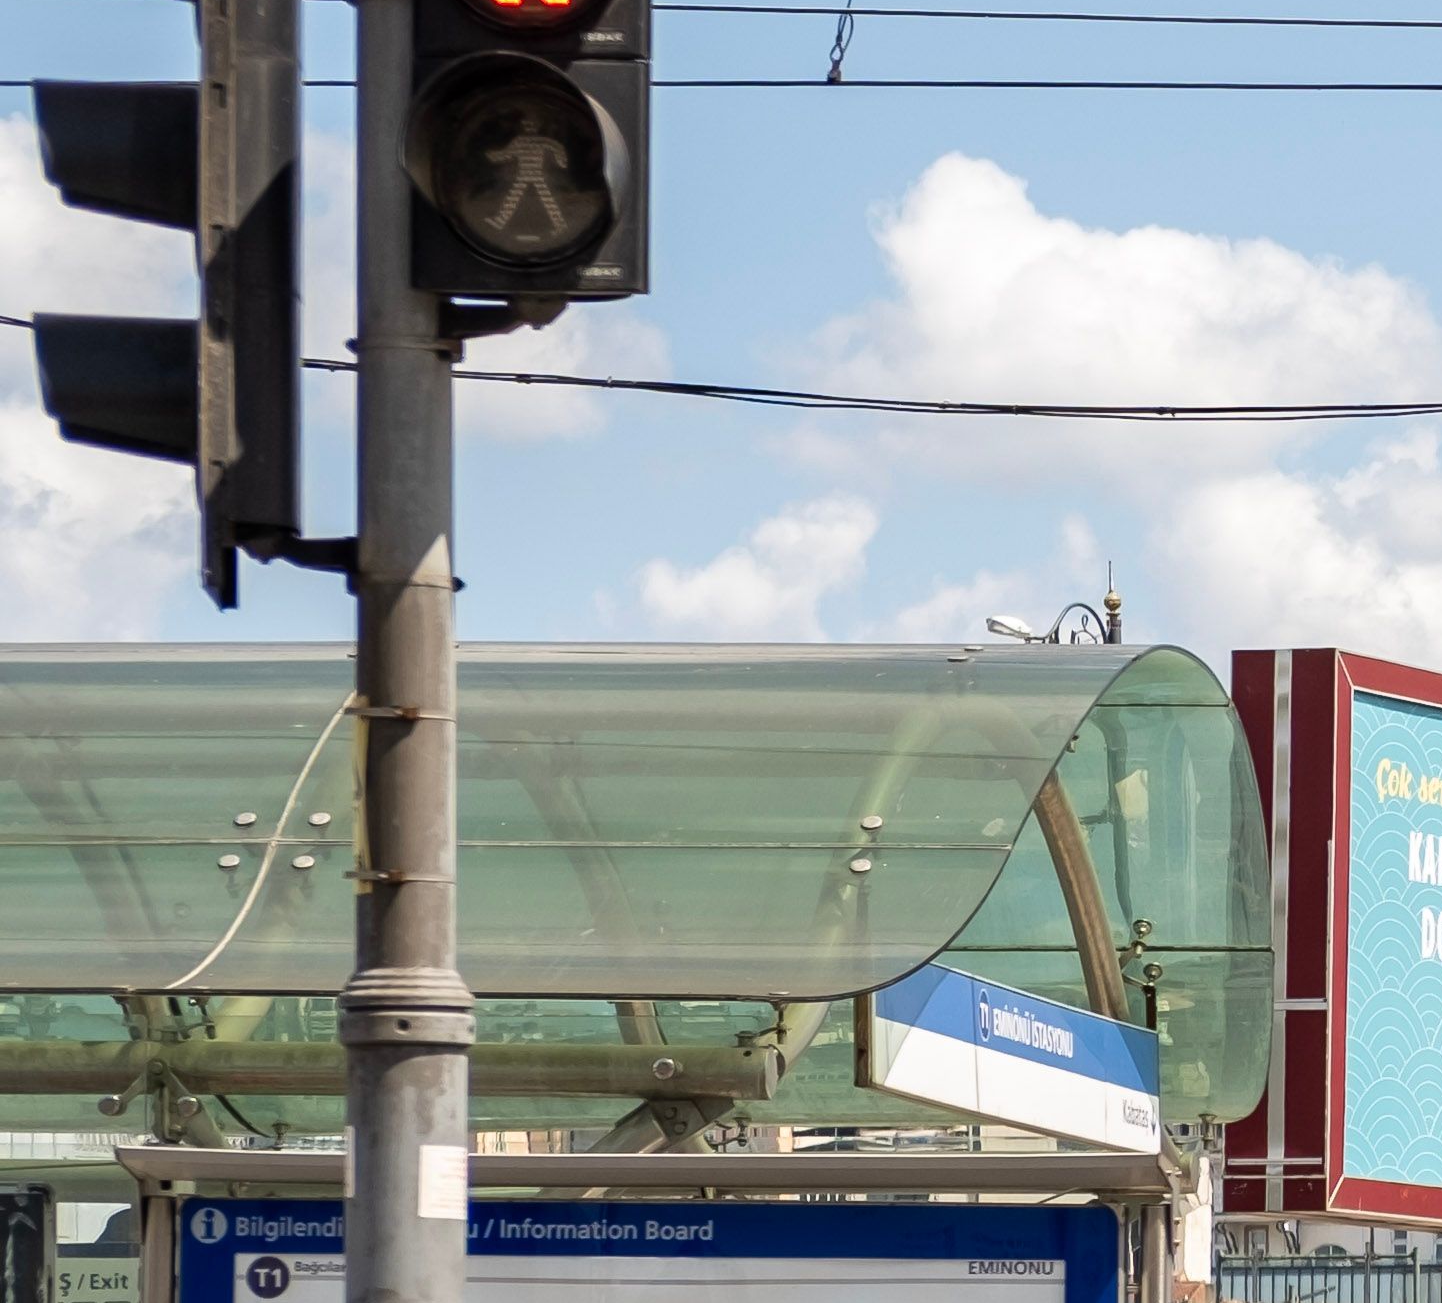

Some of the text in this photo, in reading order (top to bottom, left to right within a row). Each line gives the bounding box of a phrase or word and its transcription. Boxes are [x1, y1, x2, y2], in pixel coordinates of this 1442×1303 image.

[1377, 758, 1412, 804] Çok
[1031, 1014, 1074, 1059] İSTASYONU
[236, 1216, 343, 1241] Bilgilendi
[500, 1218, 637, 1240] Information
[645, 1220, 714, 1241] Board
[90, 1272, 128, 1290] Exit
[254, 1268, 282, 1289] T1
